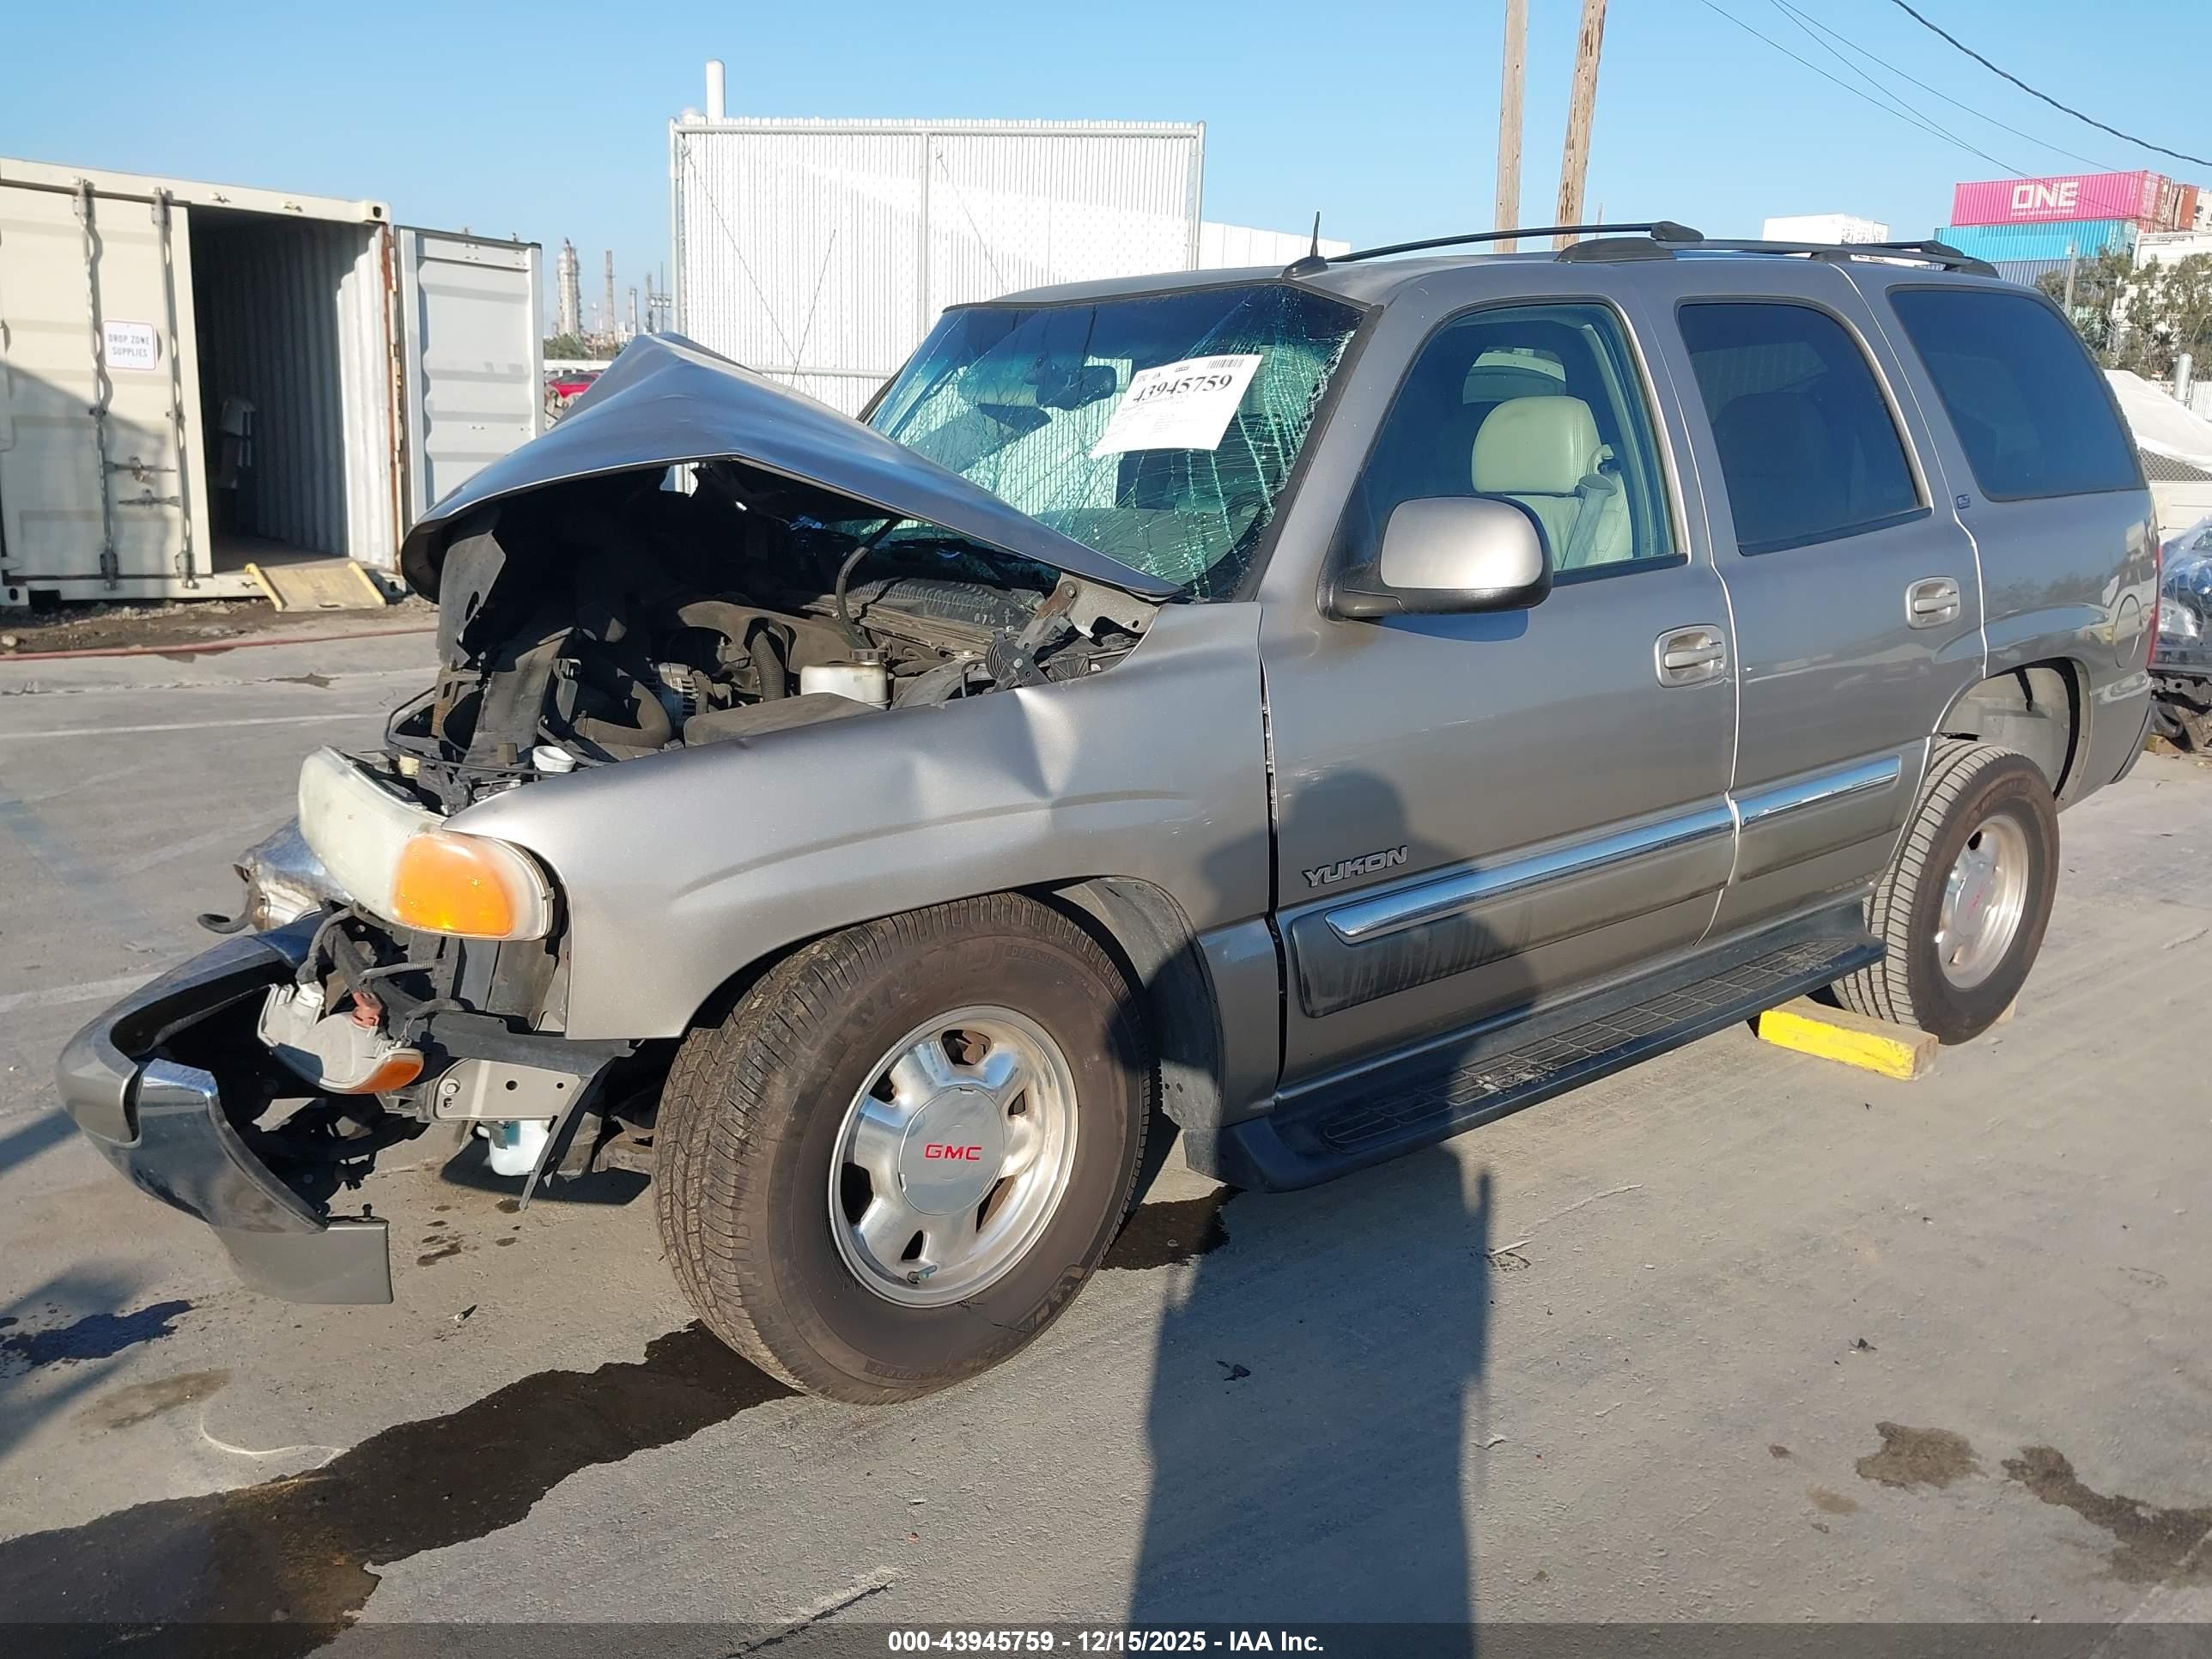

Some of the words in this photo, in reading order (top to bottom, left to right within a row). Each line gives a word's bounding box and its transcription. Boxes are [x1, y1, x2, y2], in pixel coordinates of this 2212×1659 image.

[2011, 181, 2079, 210] ONE
[109, 333, 128, 343] DROP
[131, 335, 149, 345] ZONE
[112, 346, 148, 358] SUPPLIES
[1133, 374, 1233, 403] 43945759
[1303, 846, 1407, 887] YUKON
[925, 1144, 982, 1160] GMC
